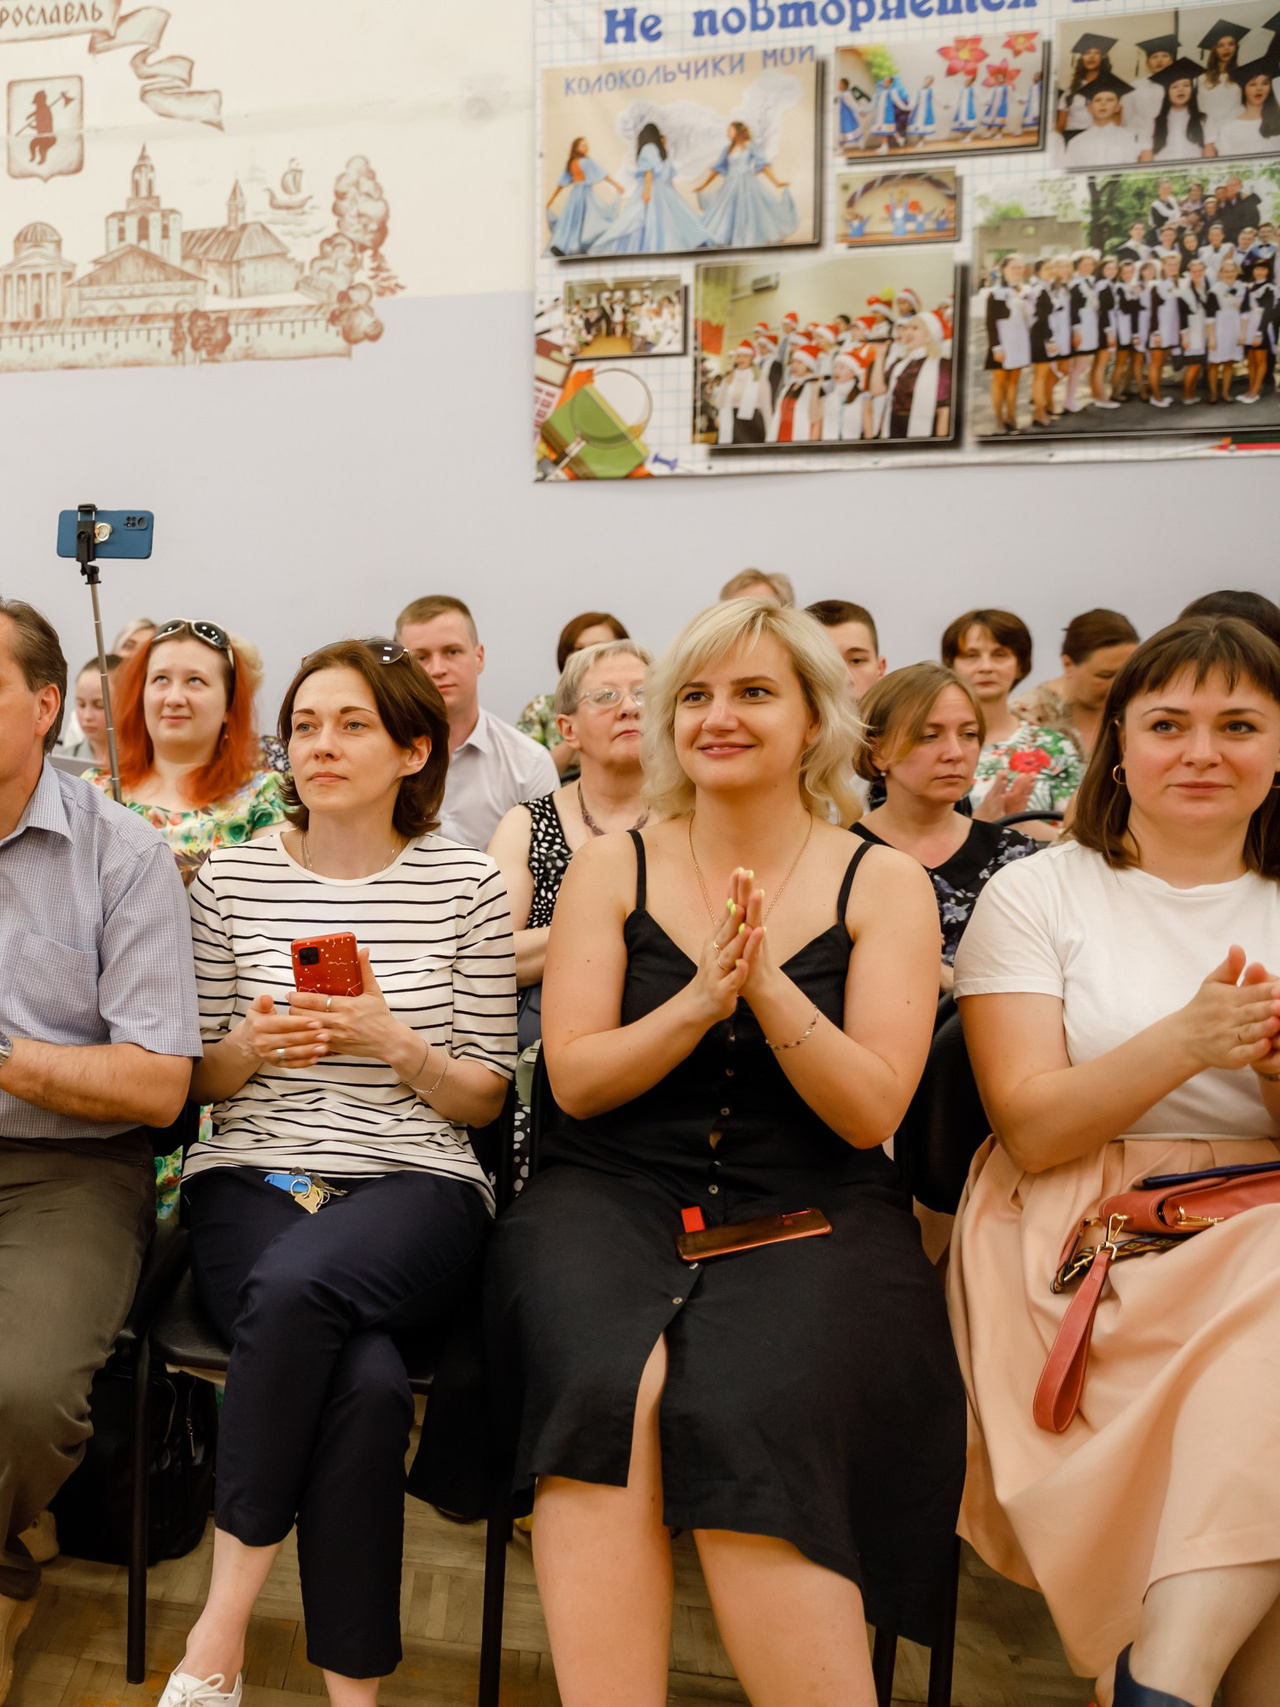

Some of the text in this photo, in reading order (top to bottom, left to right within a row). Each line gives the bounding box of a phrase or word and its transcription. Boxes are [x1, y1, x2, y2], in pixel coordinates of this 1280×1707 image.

[604, 0, 1037, 44] Не повторяет
[564, 53, 745, 96] КОЛОКОЛЬЧИКИ
